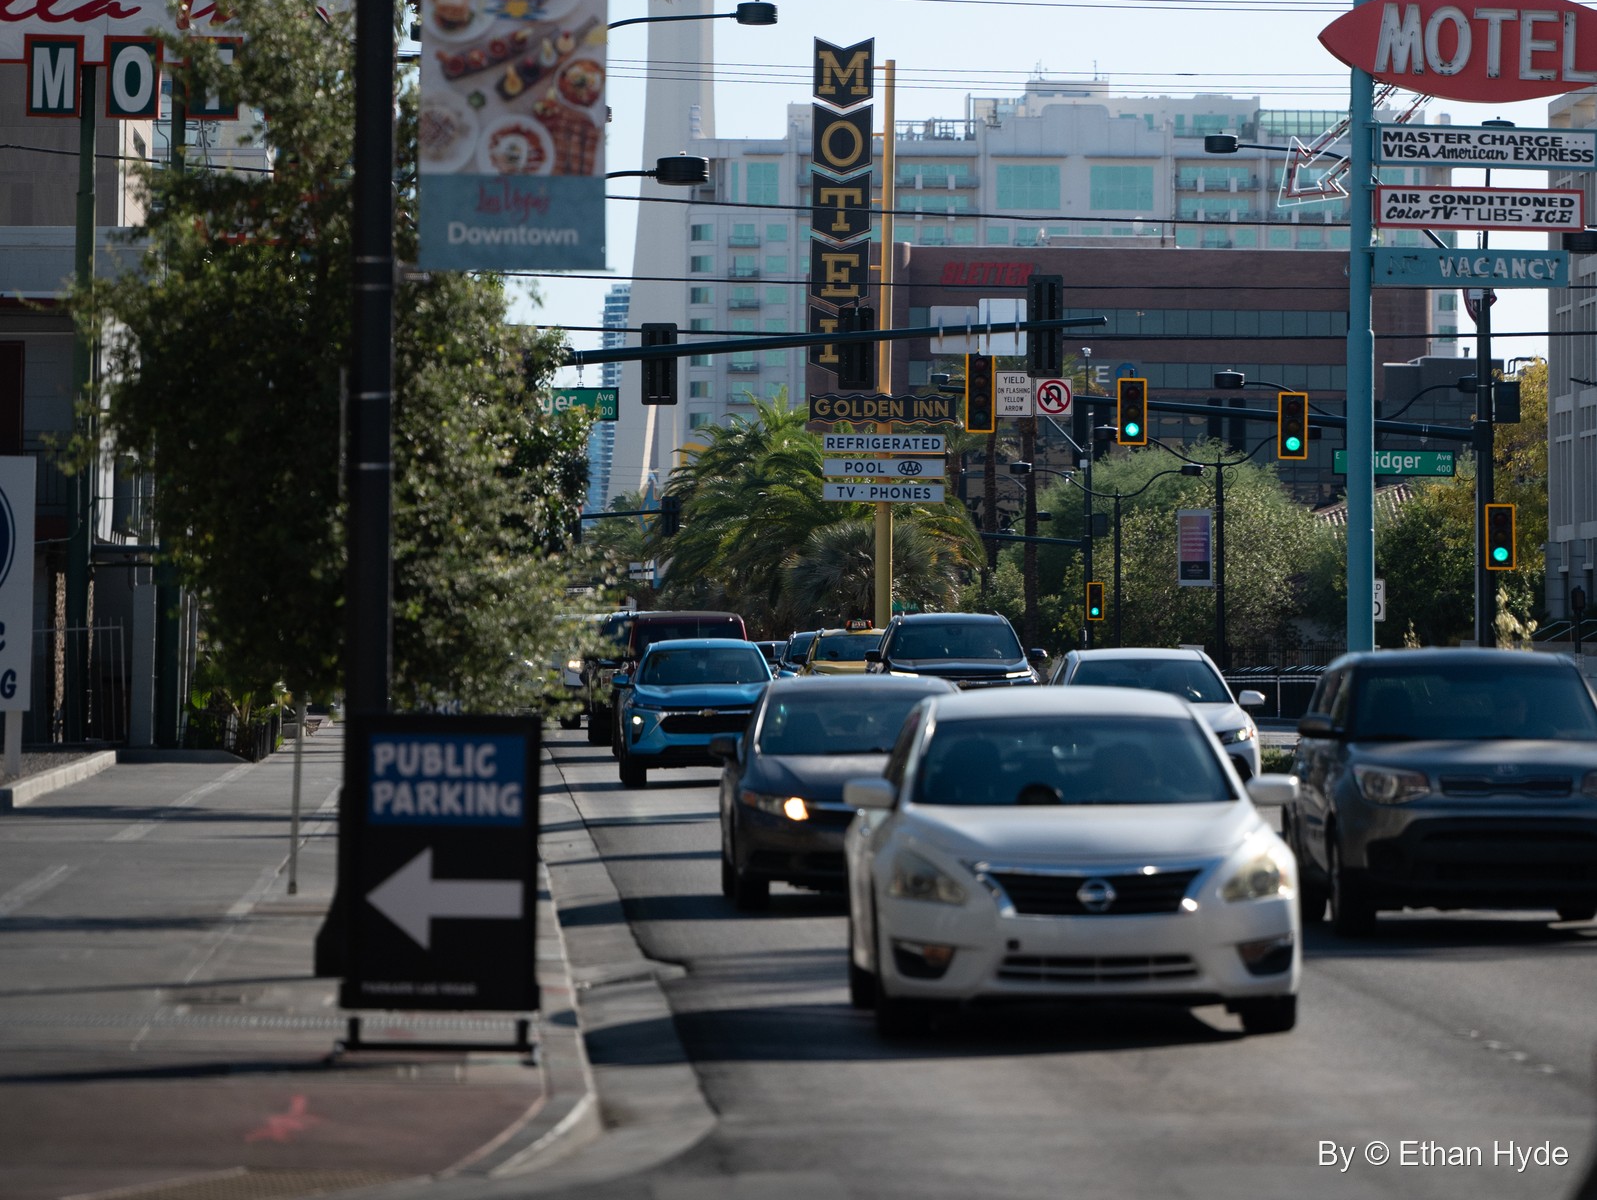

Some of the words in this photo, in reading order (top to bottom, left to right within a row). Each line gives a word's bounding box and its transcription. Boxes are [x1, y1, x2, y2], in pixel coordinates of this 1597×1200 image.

[1374, 2, 1597, 83] MOTEL
[1382, 131, 1472, 145] MASTER
[1382, 144, 1431, 159] VISA
[1431, 145, 1509, 161] American
[1513, 147, 1594, 163] EXPRESS
[1387, 193, 1421, 204] AIR
[1429, 194, 1575, 208] CONDITIONED
[1385, 206, 1430, 220] Color
[1461, 208, 1523, 222] TUBS
[1531, 209, 1573, 223] ICE
[448, 221, 579, 246] Downtown
[940, 261, 1035, 286] SLETTEN
[1438, 256, 1560, 280] VACANCY
[1003, 376, 1025, 385] YIELD
[597, 392, 614, 401] Ave
[1006, 387, 1031, 395] FLASHING
[601, 406, 613, 415] 00
[814, 399, 904, 417] GOLDEN
[913, 400, 949, 417] INN
[826, 437, 941, 450] REFRIGERATED
[845, 462, 885, 474] POOL
[1374, 451, 1422, 474] idger
[1436, 453, 1452, 461] Ave
[1436, 465, 1452, 473] 400
[837, 486, 856, 498] TV
[870, 487, 931, 499] PHONES
[372, 742, 497, 778] PUBLIC
[371, 781, 522, 818] PARKING
